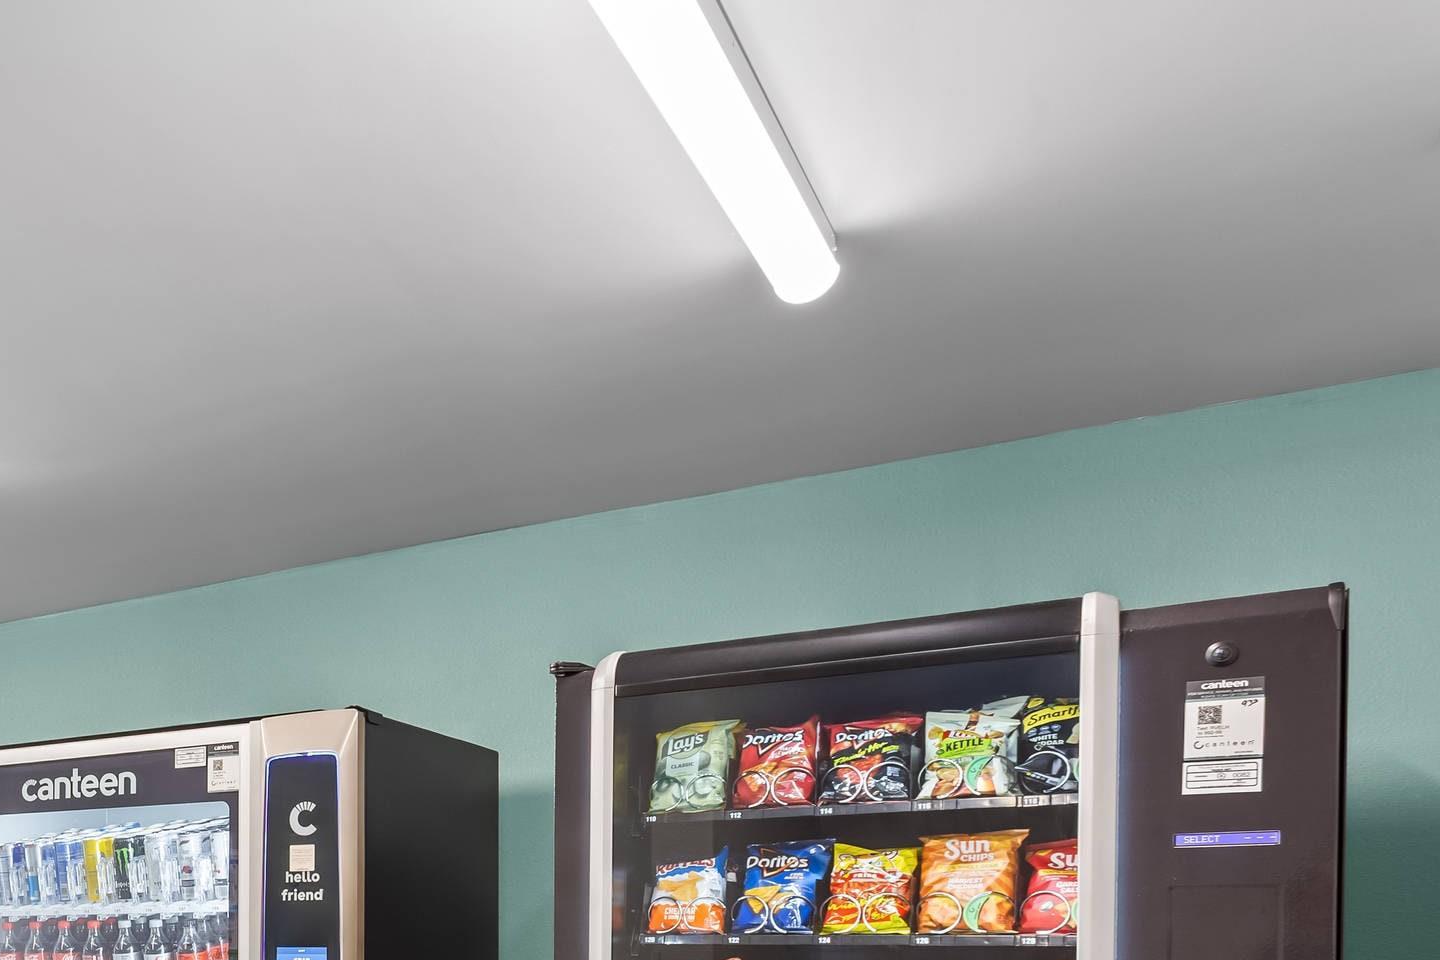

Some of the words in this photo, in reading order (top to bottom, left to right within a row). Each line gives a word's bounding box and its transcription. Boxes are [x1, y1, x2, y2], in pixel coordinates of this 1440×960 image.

[1201, 680, 1249, 689] canteen
[668, 733, 705, 756] Lay's
[945, 737, 984, 752] KETTLE
[21, 768, 137, 802] canteen
[1183, 835, 1220, 844] SELECT
[944, 839, 991, 861] Sun
[746, 855, 808, 869] Doritos
[960, 853, 995, 863] CHIPS
[285, 871, 320, 883] hello
[281, 889, 324, 901] friend
